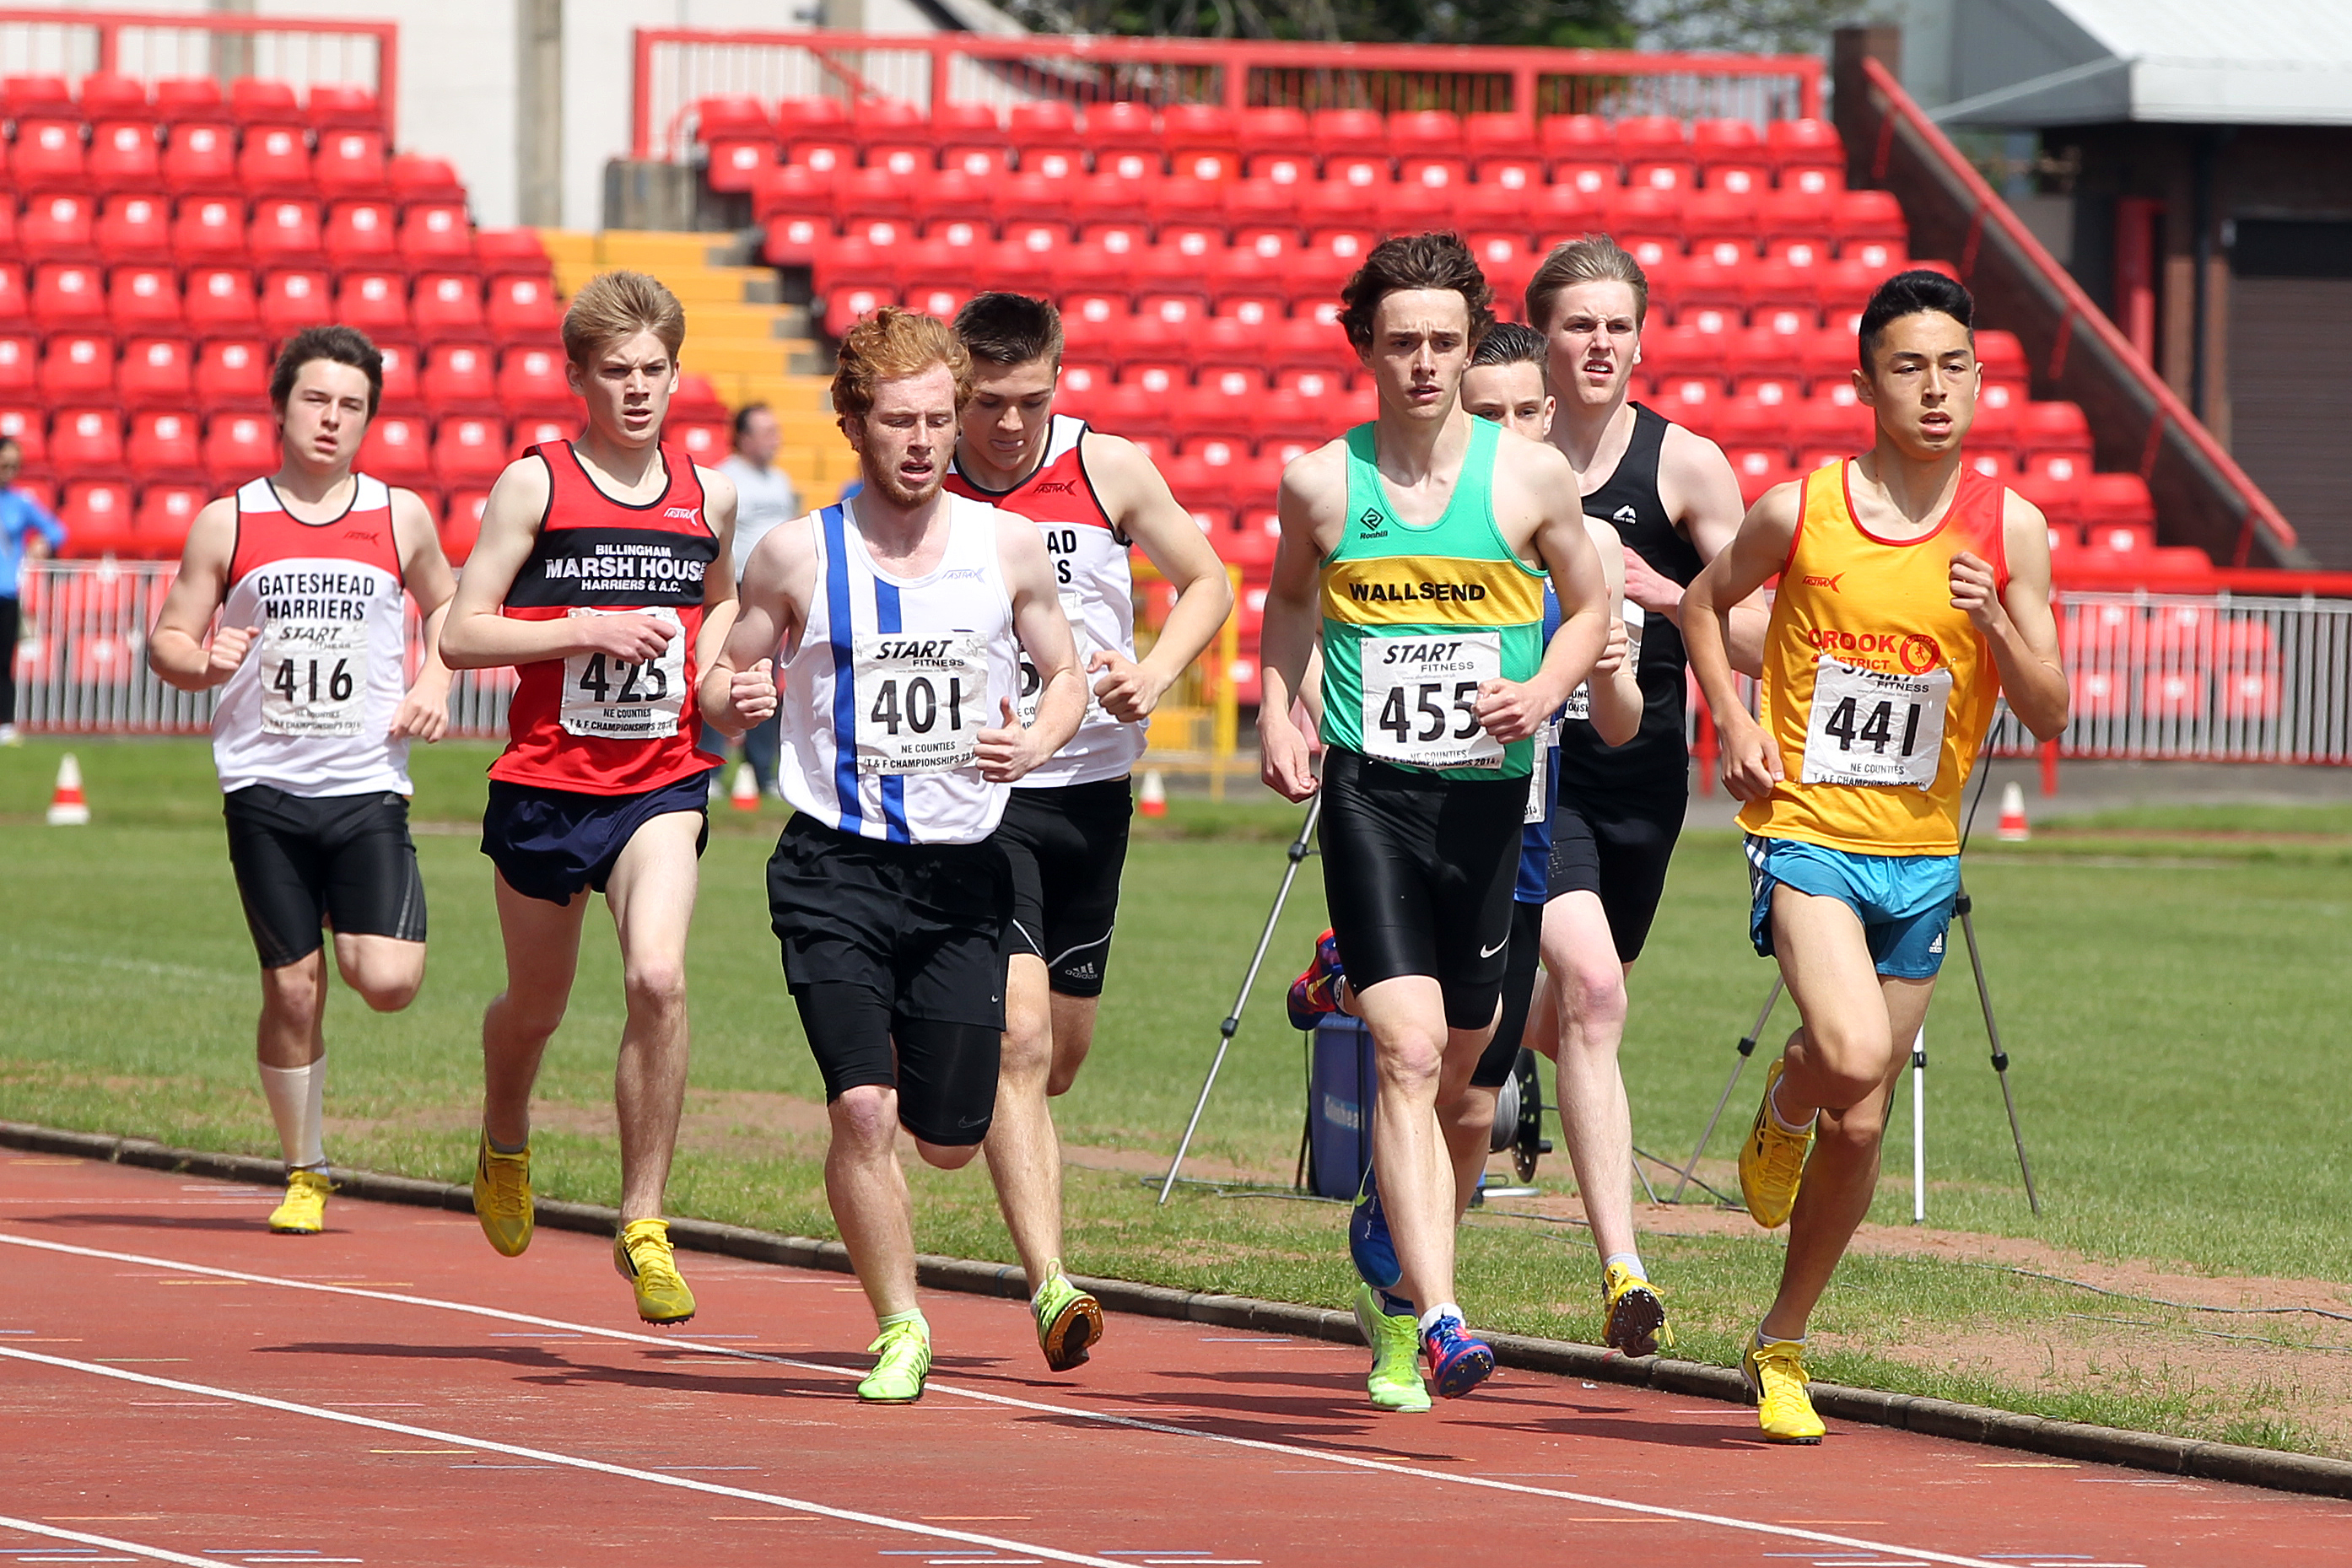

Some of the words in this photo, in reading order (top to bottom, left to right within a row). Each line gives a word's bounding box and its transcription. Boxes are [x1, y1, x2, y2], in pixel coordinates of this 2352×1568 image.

[1360, 530, 1388, 540] Ronhill
[595, 544, 672, 558] BILLINGHAM
[545, 557, 634, 579] MARSH
[640, 558, 708, 581] HOUS
[258, 573, 375, 596] GATESHEAD
[581, 579, 645, 590] HARRIERS
[647, 579, 656, 591] &
[658, 580, 682, 593] A.C.
[1349, 582, 1486, 601] WALLSEND
[266, 598, 365, 620] HARRIERS
[279, 627, 342, 641] START
[1808, 628, 1896, 653] CROOK
[876, 640, 953, 660] START
[1383, 642, 1463, 664] START
[913, 659, 964, 667] FITNESS
[1421, 661, 1474, 672] FITNESS
[1834, 656, 1890, 670] STRICT
[273, 657, 353, 702] 416
[580, 649, 667, 703] 425
[1877, 681, 1929, 692] FITNESS
[871, 676, 961, 735] 401
[1379, 682, 1482, 743] 455
[603, 708, 615, 718] NE
[617, 708, 651, 718] COUNTIES
[569, 718, 575, 726] T
[575, 719, 582, 728] &
[584, 720, 590, 729] F
[591, 720, 655, 732] CHAMPIONSHIPS
[1825, 696, 1921, 757] 441
[901, 744, 913, 753] NE
[915, 741, 956, 753] COUNTIES
[873, 759, 880, 768] &
[882, 759, 888, 768] F
[890, 754, 959, 769] CHAMPIONSHIPS
[960, 751, 976, 762] 201
[1424, 749, 1468, 760] COUNTIES
[1472, 757, 1495, 767] 2014
[1850, 762, 1861, 773] NE
[1864, 763, 1904, 775] COUNTIES
[1814, 773, 1819, 781] T
[1821, 774, 1827, 783] &
[1830, 774, 1835, 783] F
[1065, 968, 1098, 980] adidas
